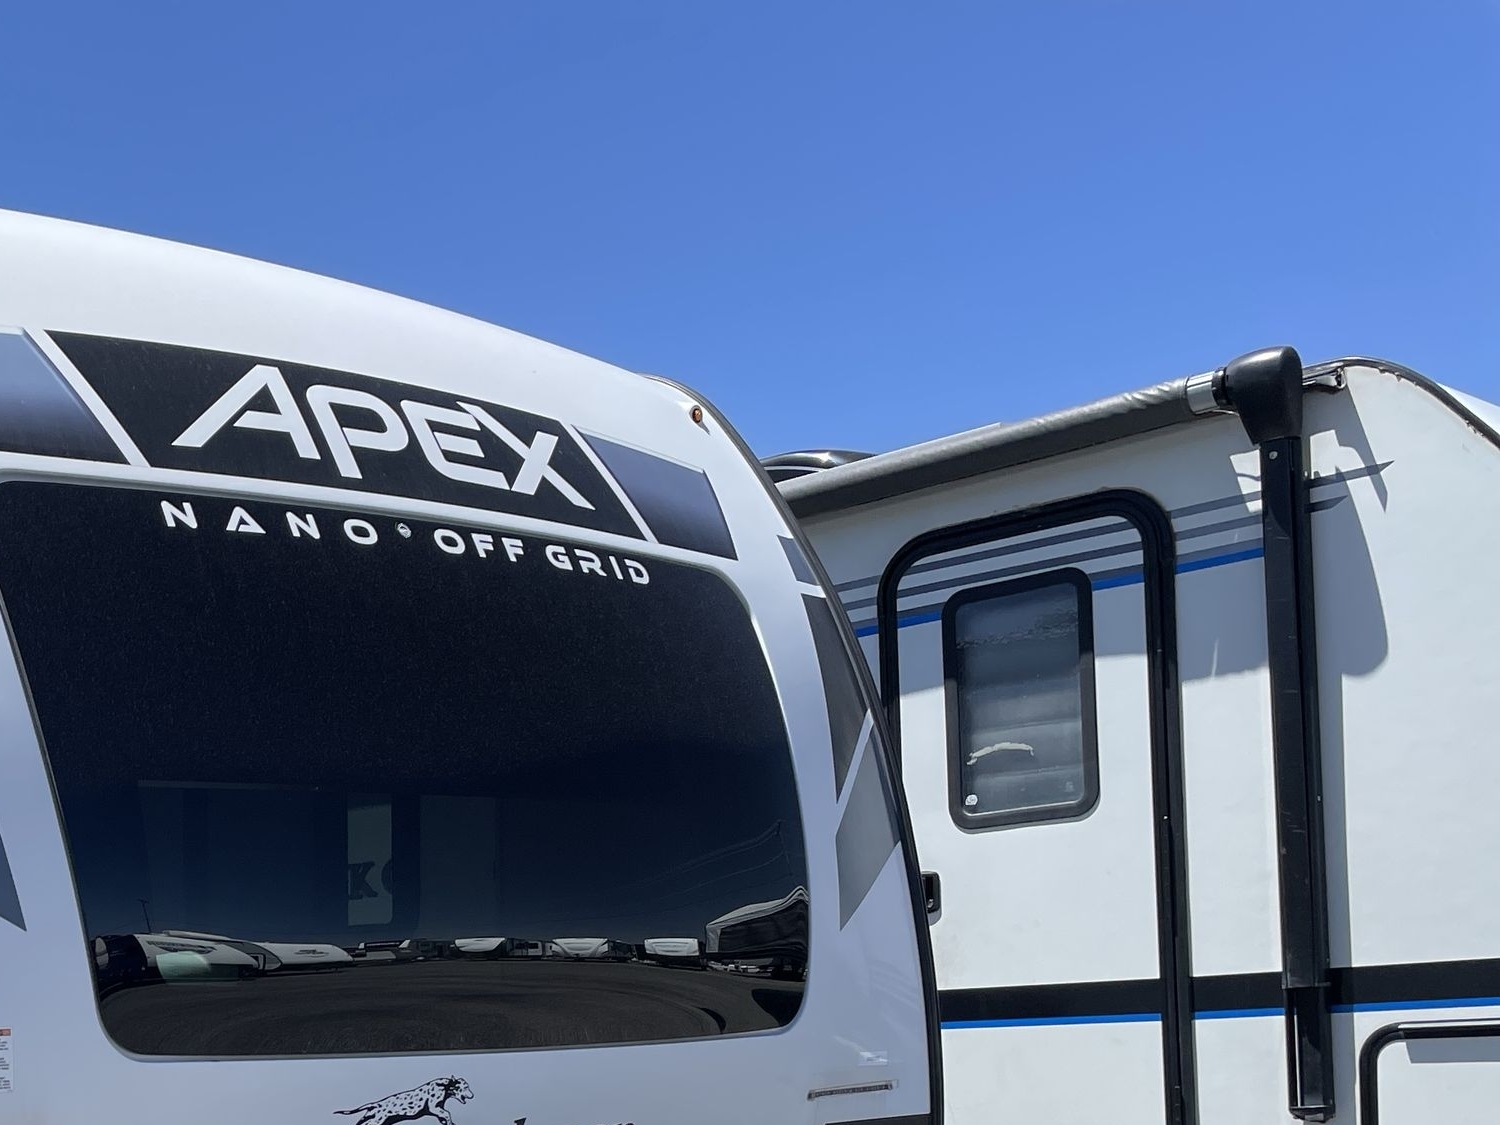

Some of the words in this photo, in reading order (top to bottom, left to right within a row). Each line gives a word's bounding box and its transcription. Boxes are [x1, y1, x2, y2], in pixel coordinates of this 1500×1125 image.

[172, 364, 596, 510] APEX
[160, 500, 378, 546] NANO
[433, 528, 524, 562] OFF
[544, 544, 650, 585] GRID
